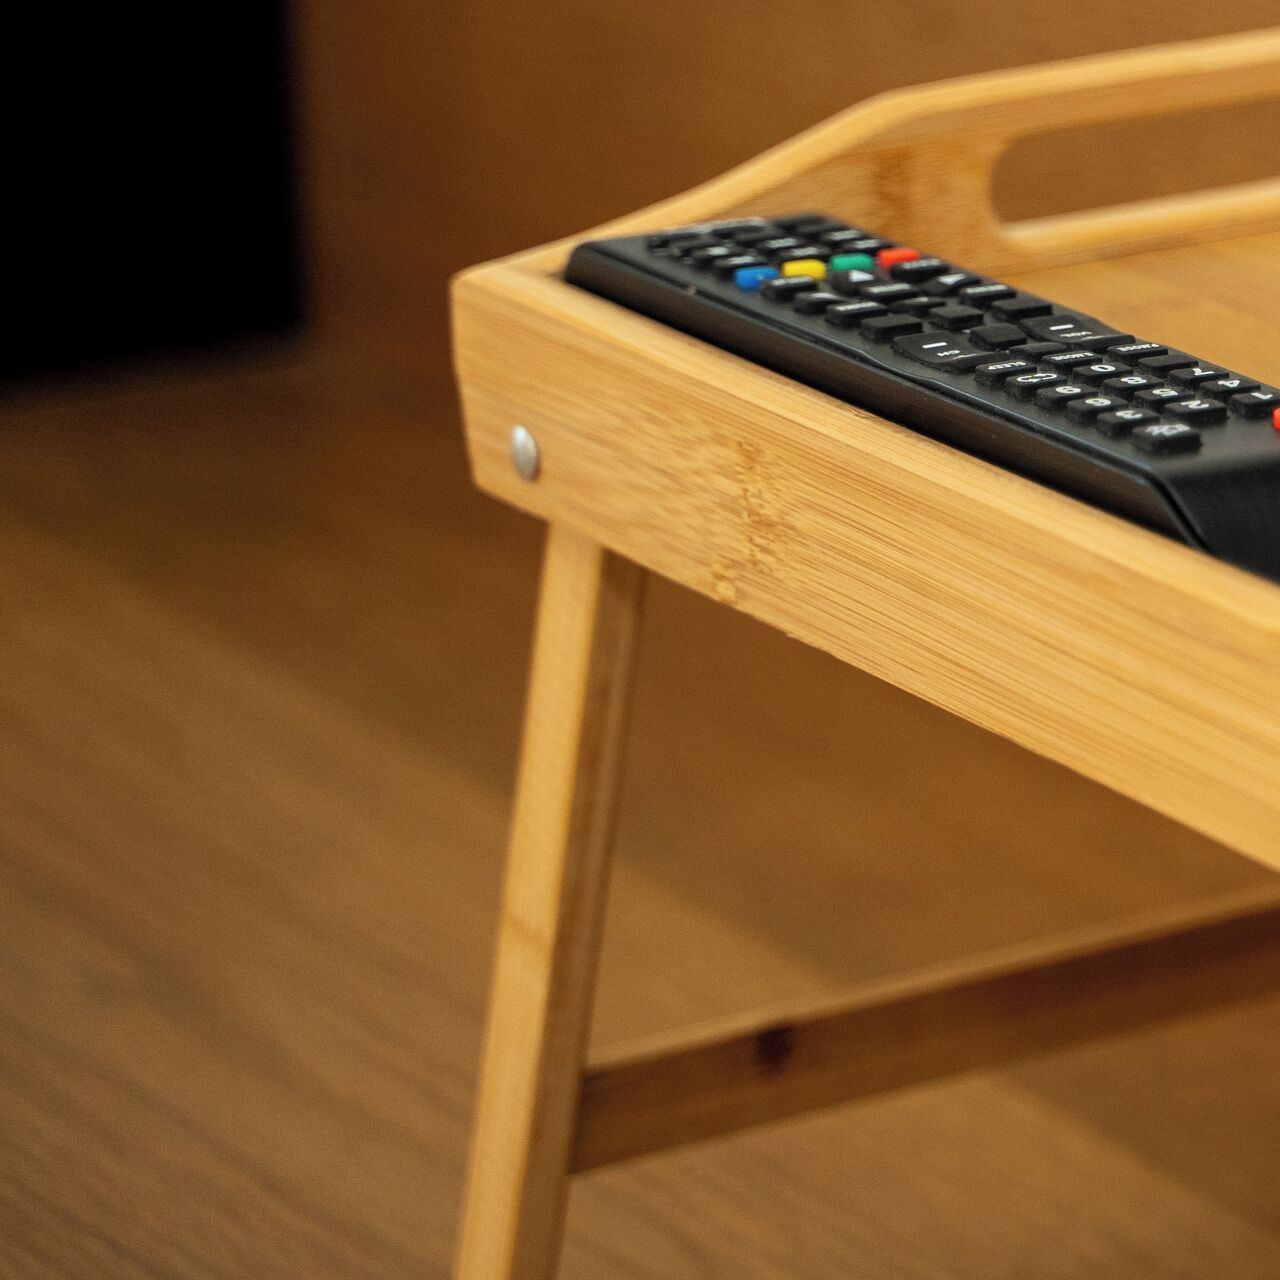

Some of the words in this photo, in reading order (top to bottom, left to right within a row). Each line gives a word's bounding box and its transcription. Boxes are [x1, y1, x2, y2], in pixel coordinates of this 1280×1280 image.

[988, 361, 1027, 370] SLEEP
[1090, 364, 1116, 372] 0
[1192, 367, 1215, 376] 7
[1120, 376, 1147, 385] 8
[1217, 379, 1241, 388] 4
[1055, 385, 1082, 394] 9
[1152, 388, 1179, 397] 5
[1251, 391, 1274, 400] 1
[1085, 398, 1112, 407] 6
[1180, 400, 1209, 410] 2
[1115, 410, 1144, 420] 3
